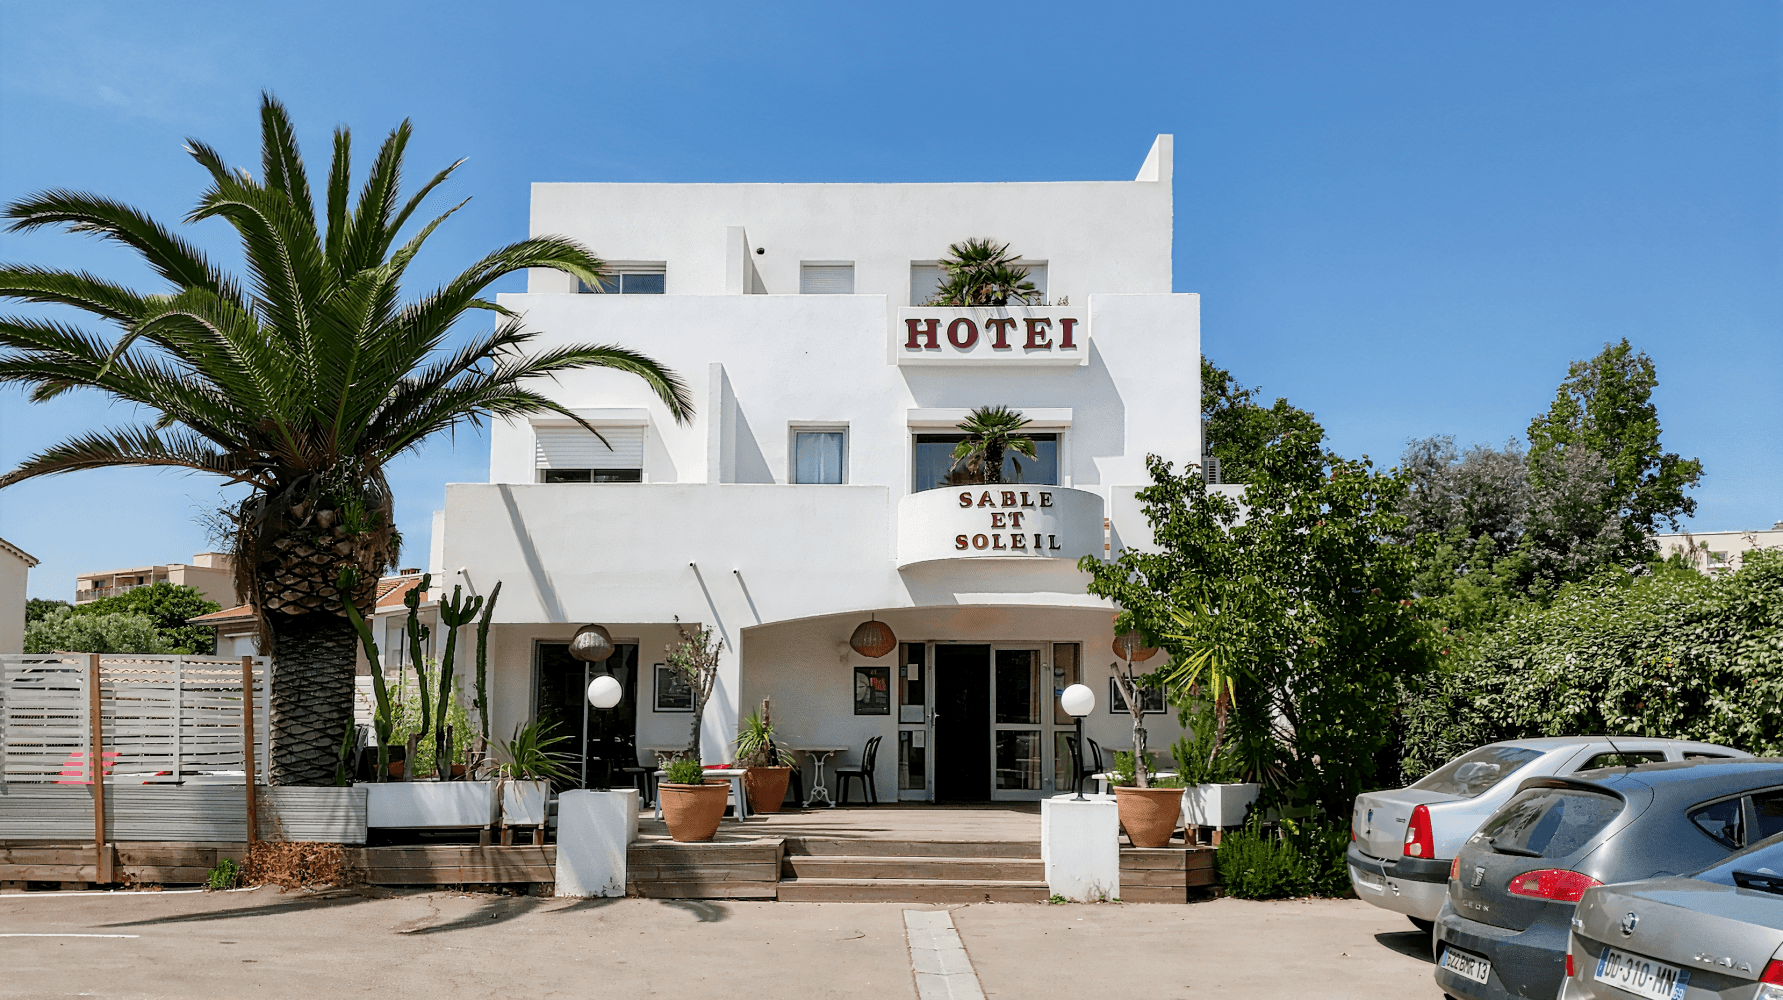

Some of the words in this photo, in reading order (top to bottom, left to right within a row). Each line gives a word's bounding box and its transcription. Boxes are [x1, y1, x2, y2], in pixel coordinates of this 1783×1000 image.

[959, 491, 1053, 508] SABLE
[991, 511, 1024, 528] ET
[955, 533, 1061, 550] SOLEIL
